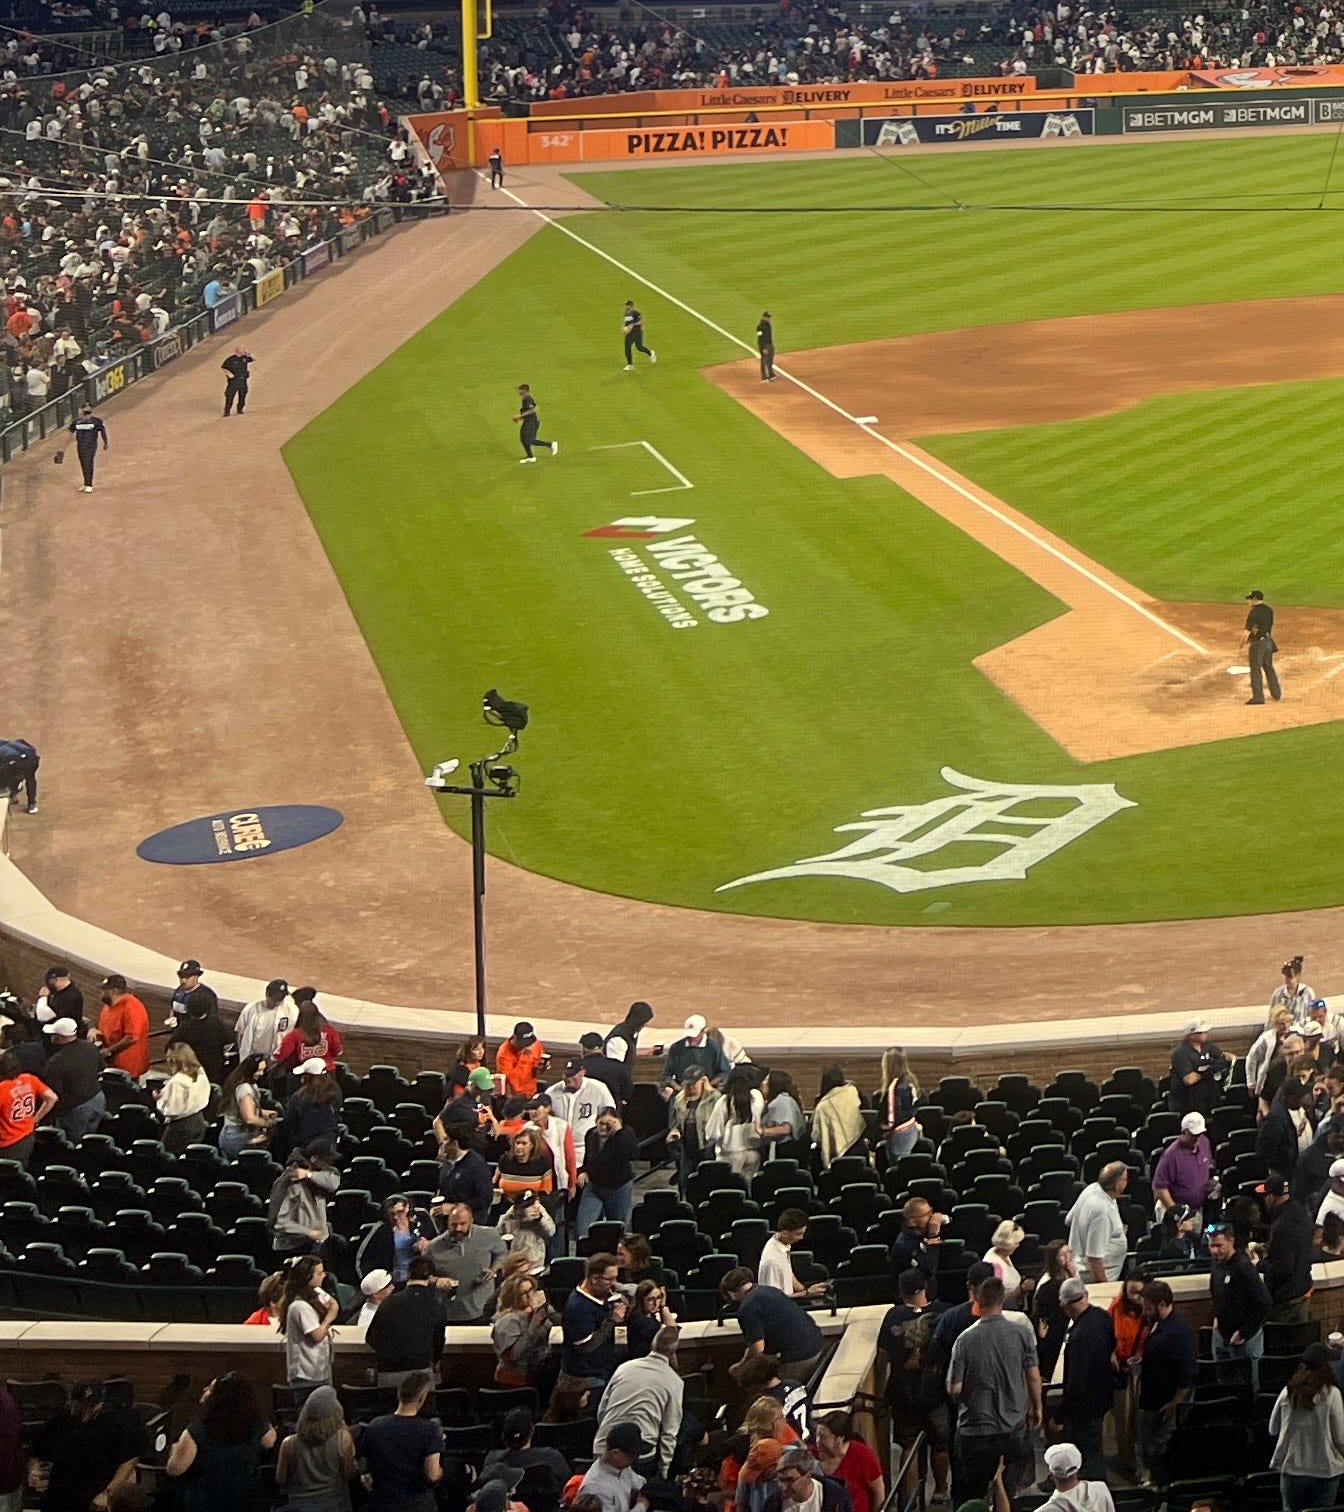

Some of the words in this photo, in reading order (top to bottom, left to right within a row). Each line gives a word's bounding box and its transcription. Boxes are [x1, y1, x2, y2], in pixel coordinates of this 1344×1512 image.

[701, 93, 732, 106] Little
[884, 88, 913, 99] Little
[953, 116, 1004, 139] Miller
[996, 120, 1022, 132] TIME
[1144, 110, 1213, 126] BETMGM
[1237, 106, 1305, 122] BETMGM
[628, 131, 704, 154] PIZZA!
[712, 128, 787, 150] PIZZA!
[608, 547, 650, 575] HOME
[631, 574, 698, 629] SOLUTIONS
[645, 535, 769, 623] VICTORS
[12, 1095, 35, 1122] 29
